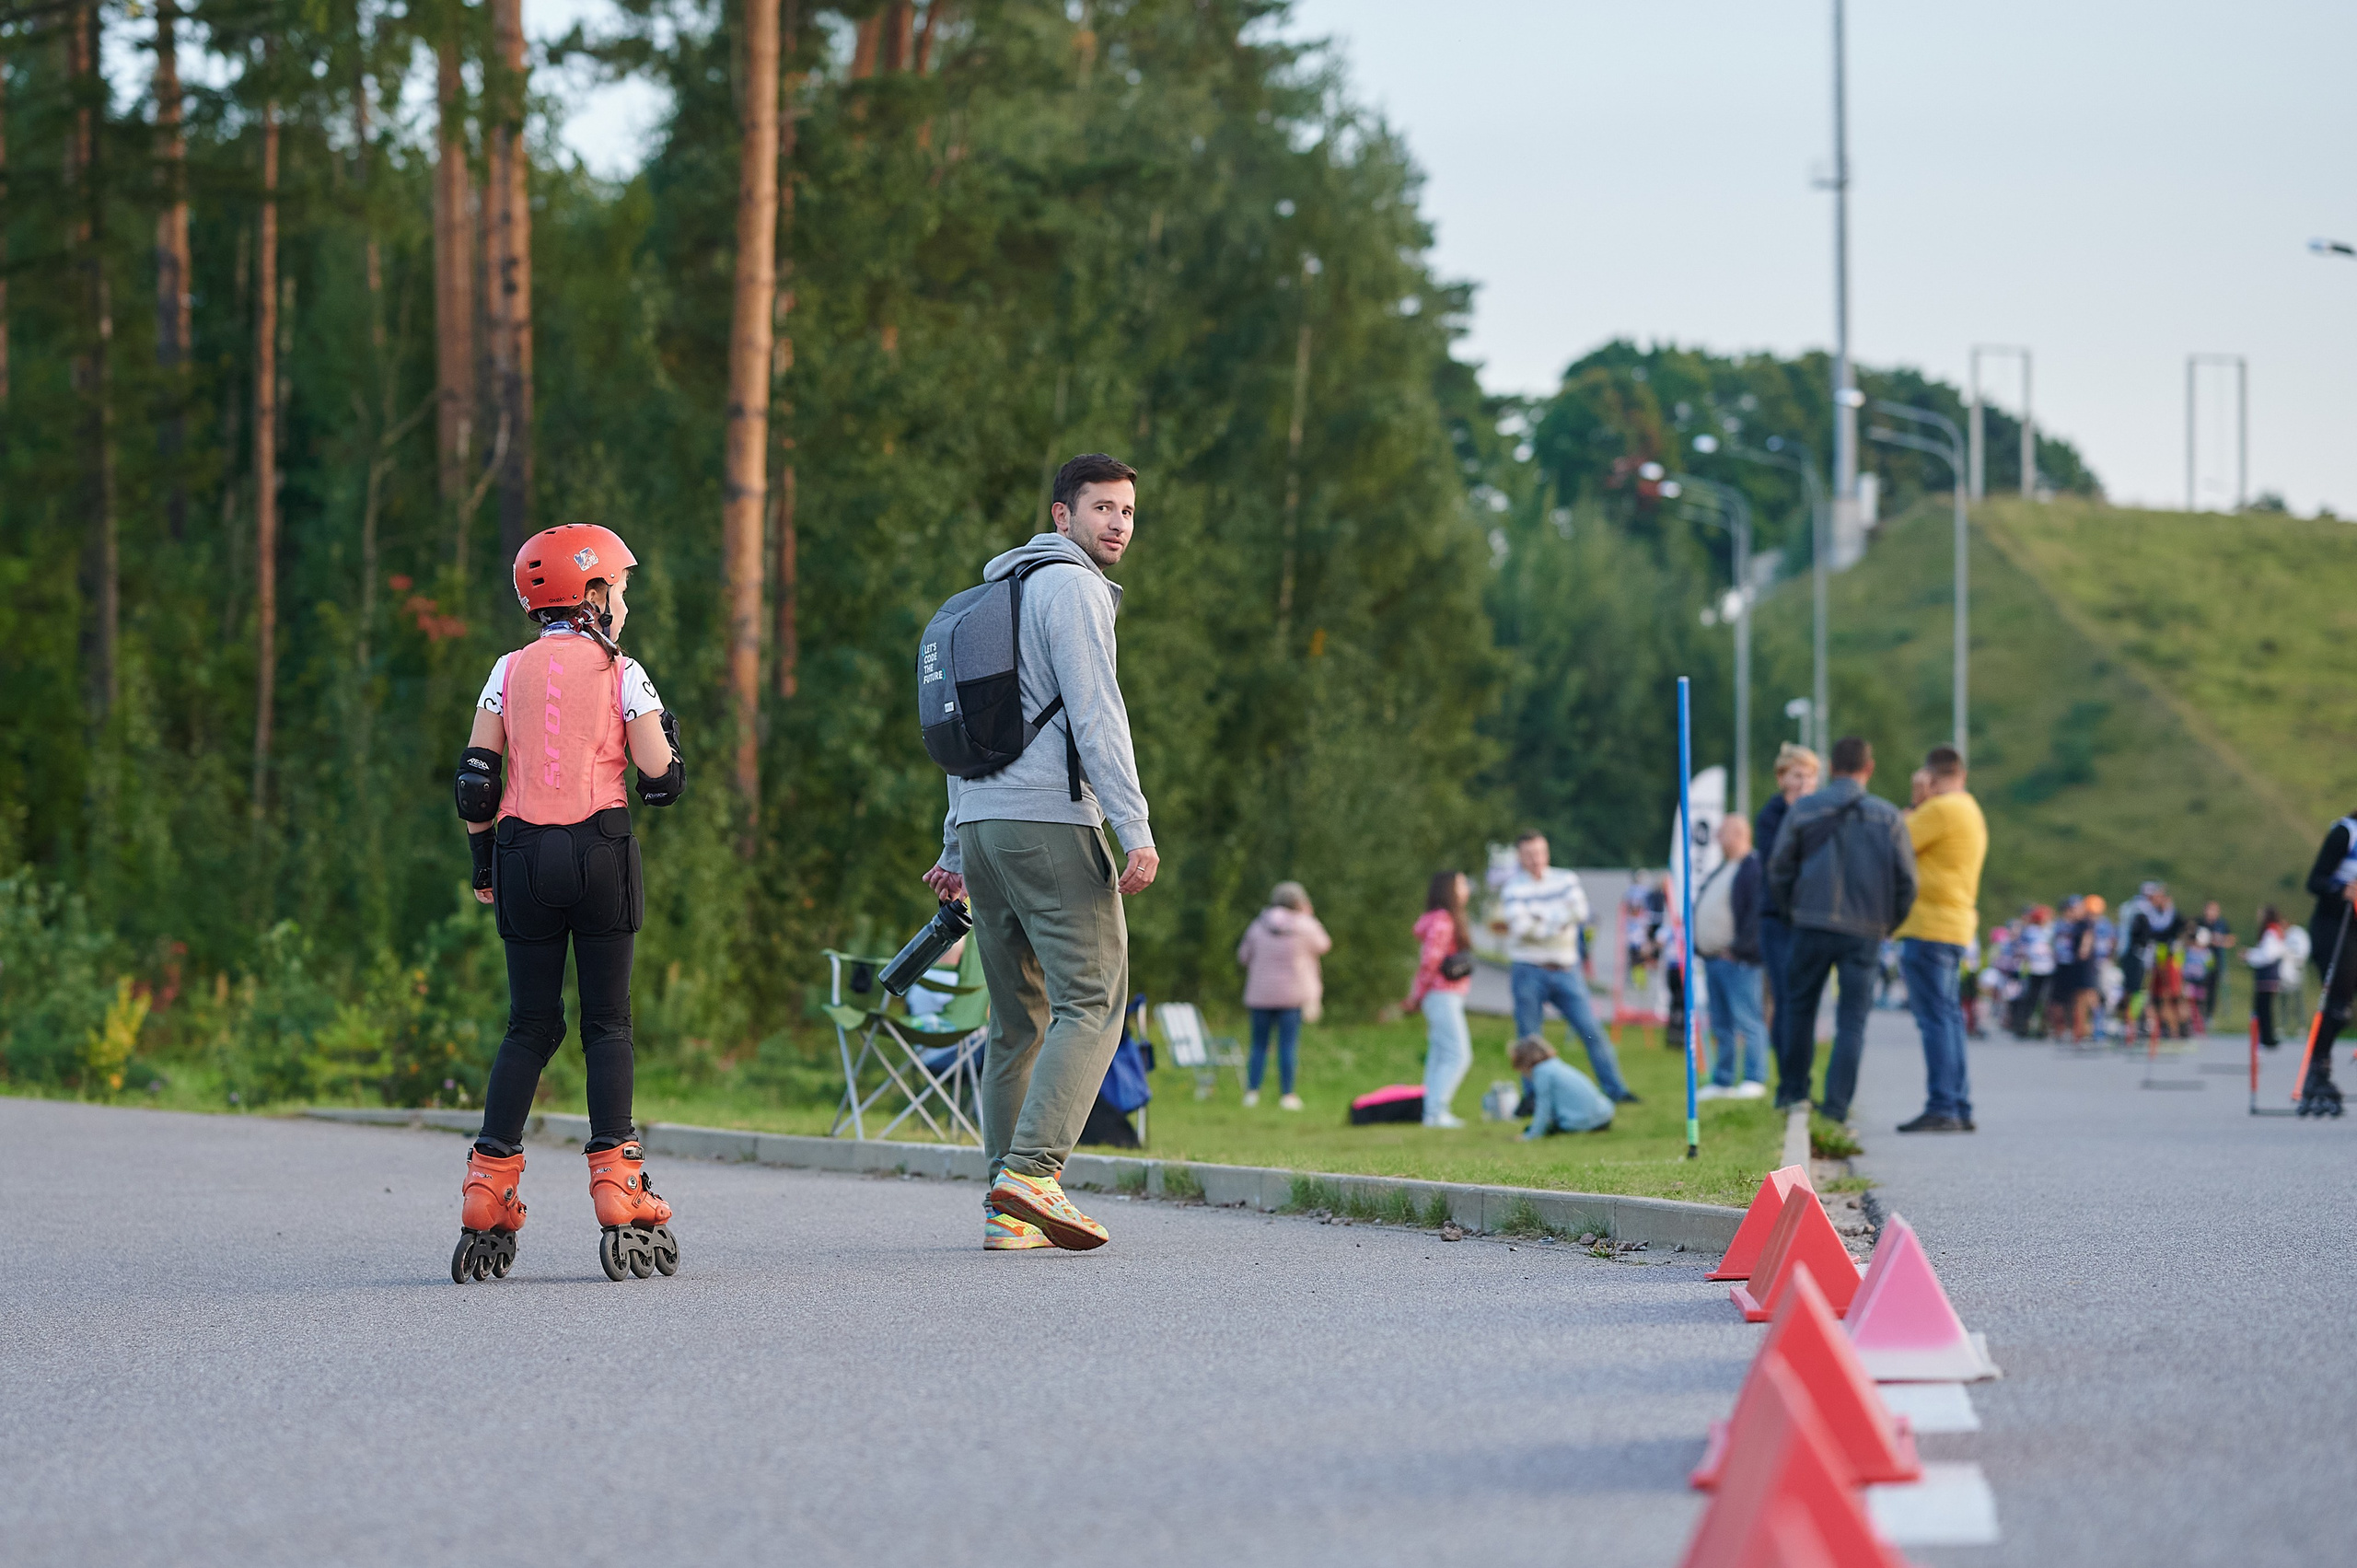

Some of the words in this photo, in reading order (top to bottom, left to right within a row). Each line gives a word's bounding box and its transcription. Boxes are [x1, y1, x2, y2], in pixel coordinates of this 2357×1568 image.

[923, 652, 937, 664] CODE
[923, 663, 934, 674] THE
[545, 654, 563, 789] SCOTT
